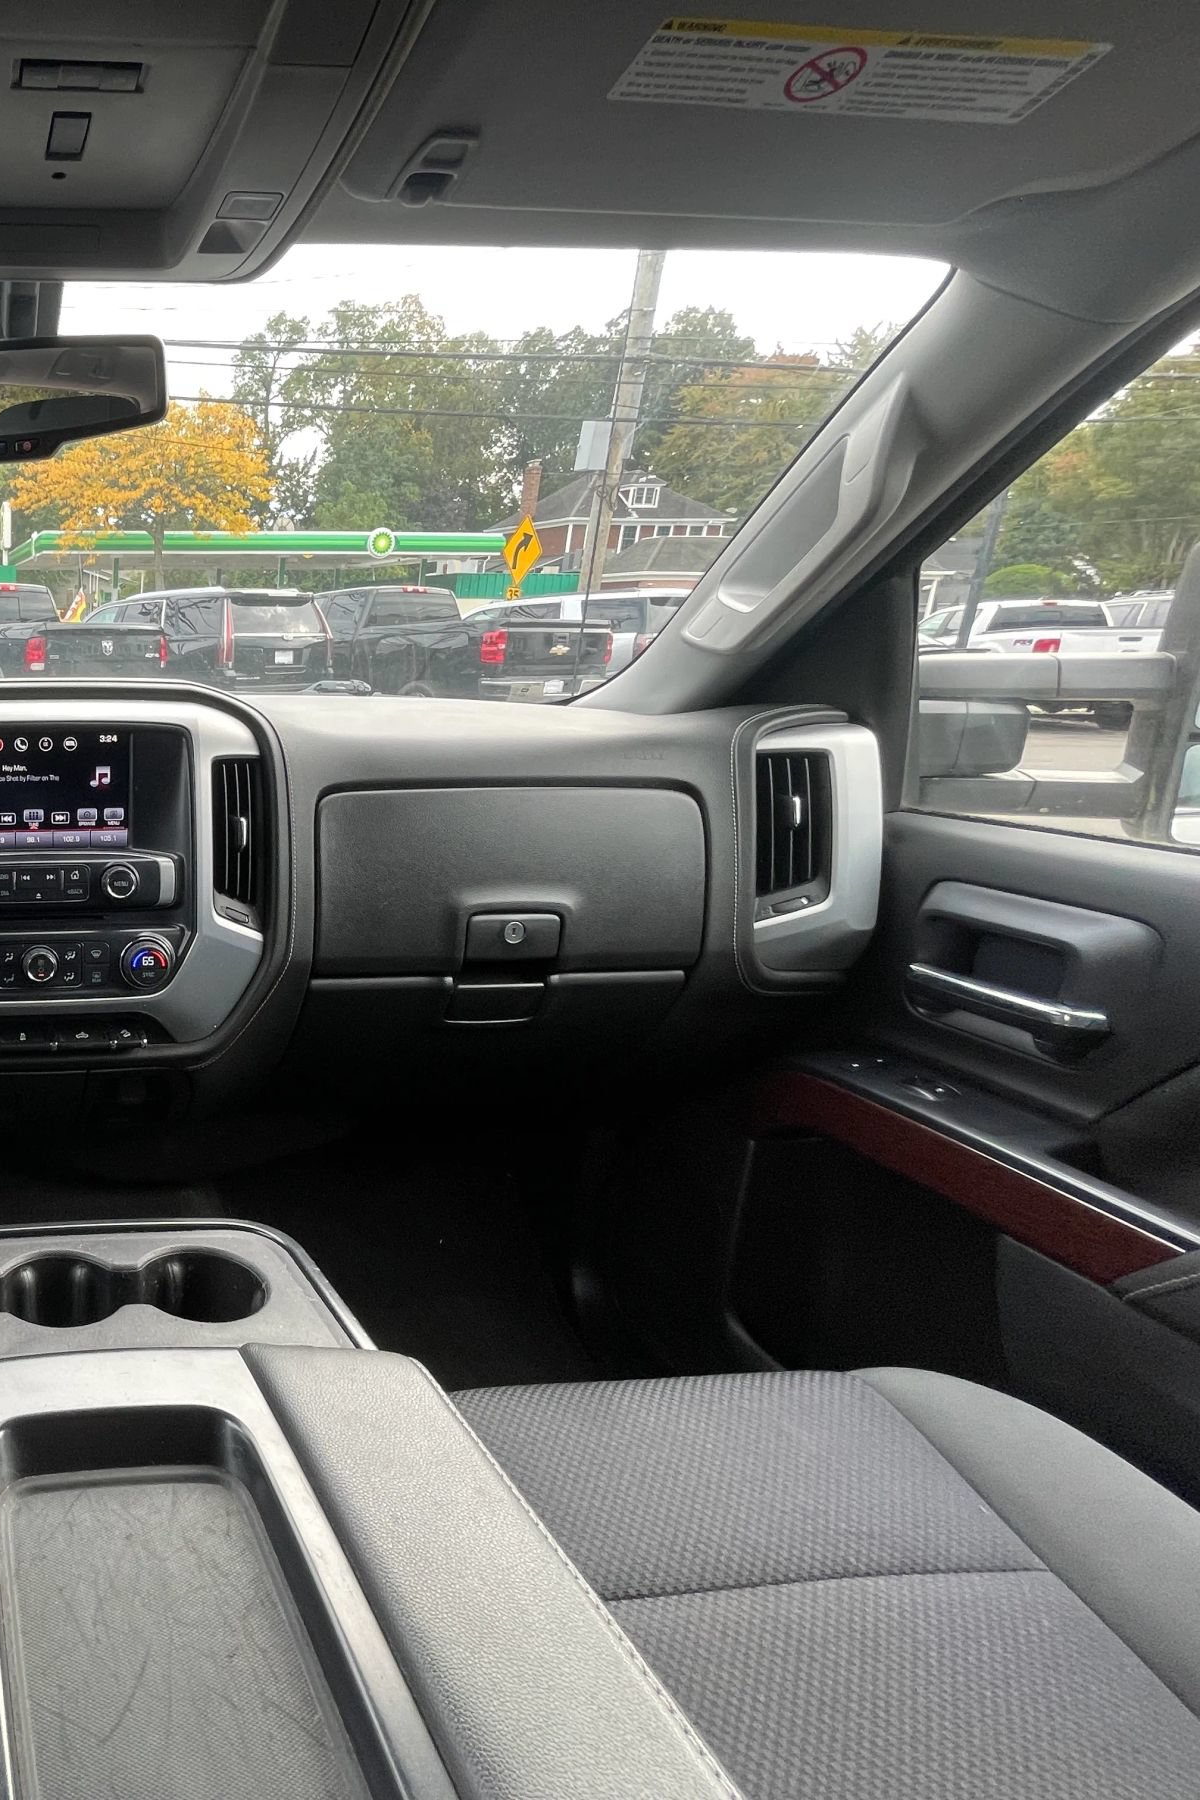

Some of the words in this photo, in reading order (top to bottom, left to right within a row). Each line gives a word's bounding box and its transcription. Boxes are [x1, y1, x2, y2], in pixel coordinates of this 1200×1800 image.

[99, 735, 118, 743] 3:24
[2, 765, 13, 773] Hey
[142, 956, 155, 966] 65
